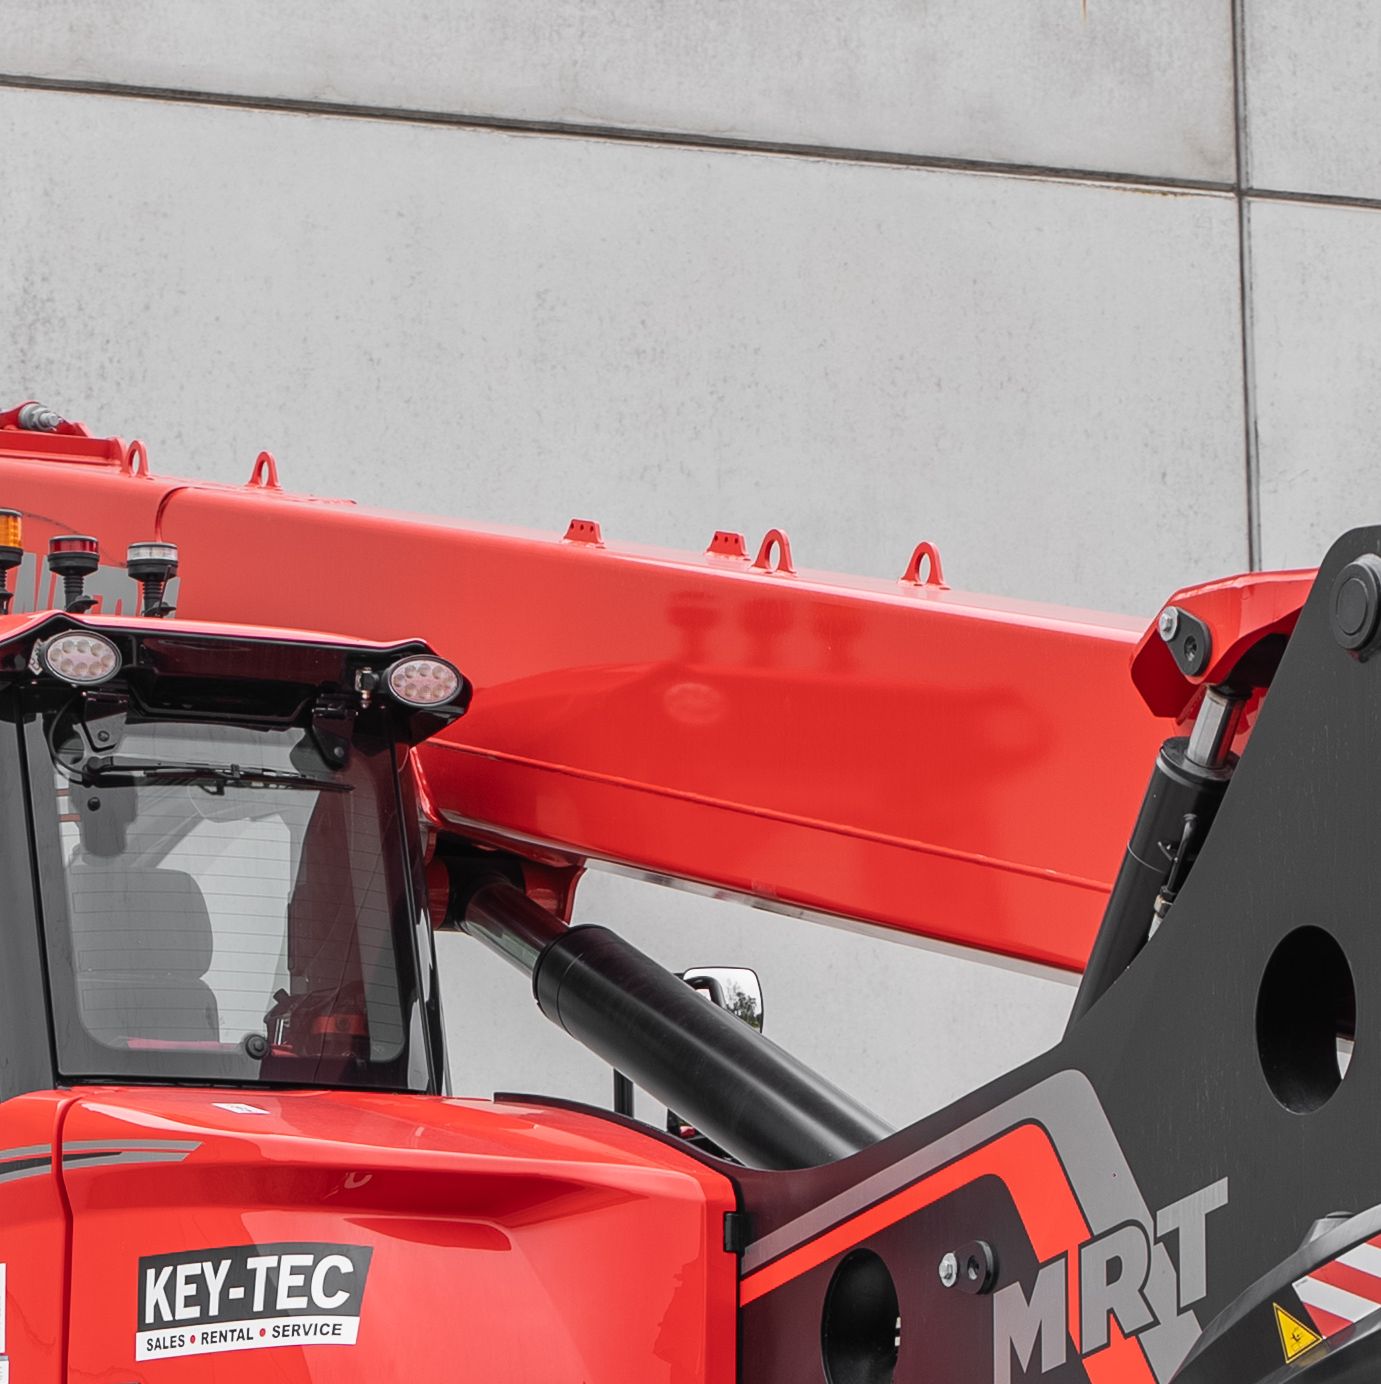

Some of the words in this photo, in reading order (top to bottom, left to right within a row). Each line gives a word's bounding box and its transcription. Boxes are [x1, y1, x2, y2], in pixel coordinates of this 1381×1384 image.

[144, 1254, 354, 1324] KEY-TEC
[146, 1334, 186, 1352] SALES
[201, 1327, 254, 1346] RENTAL
[271, 1323, 343, 1339] SERVICE
